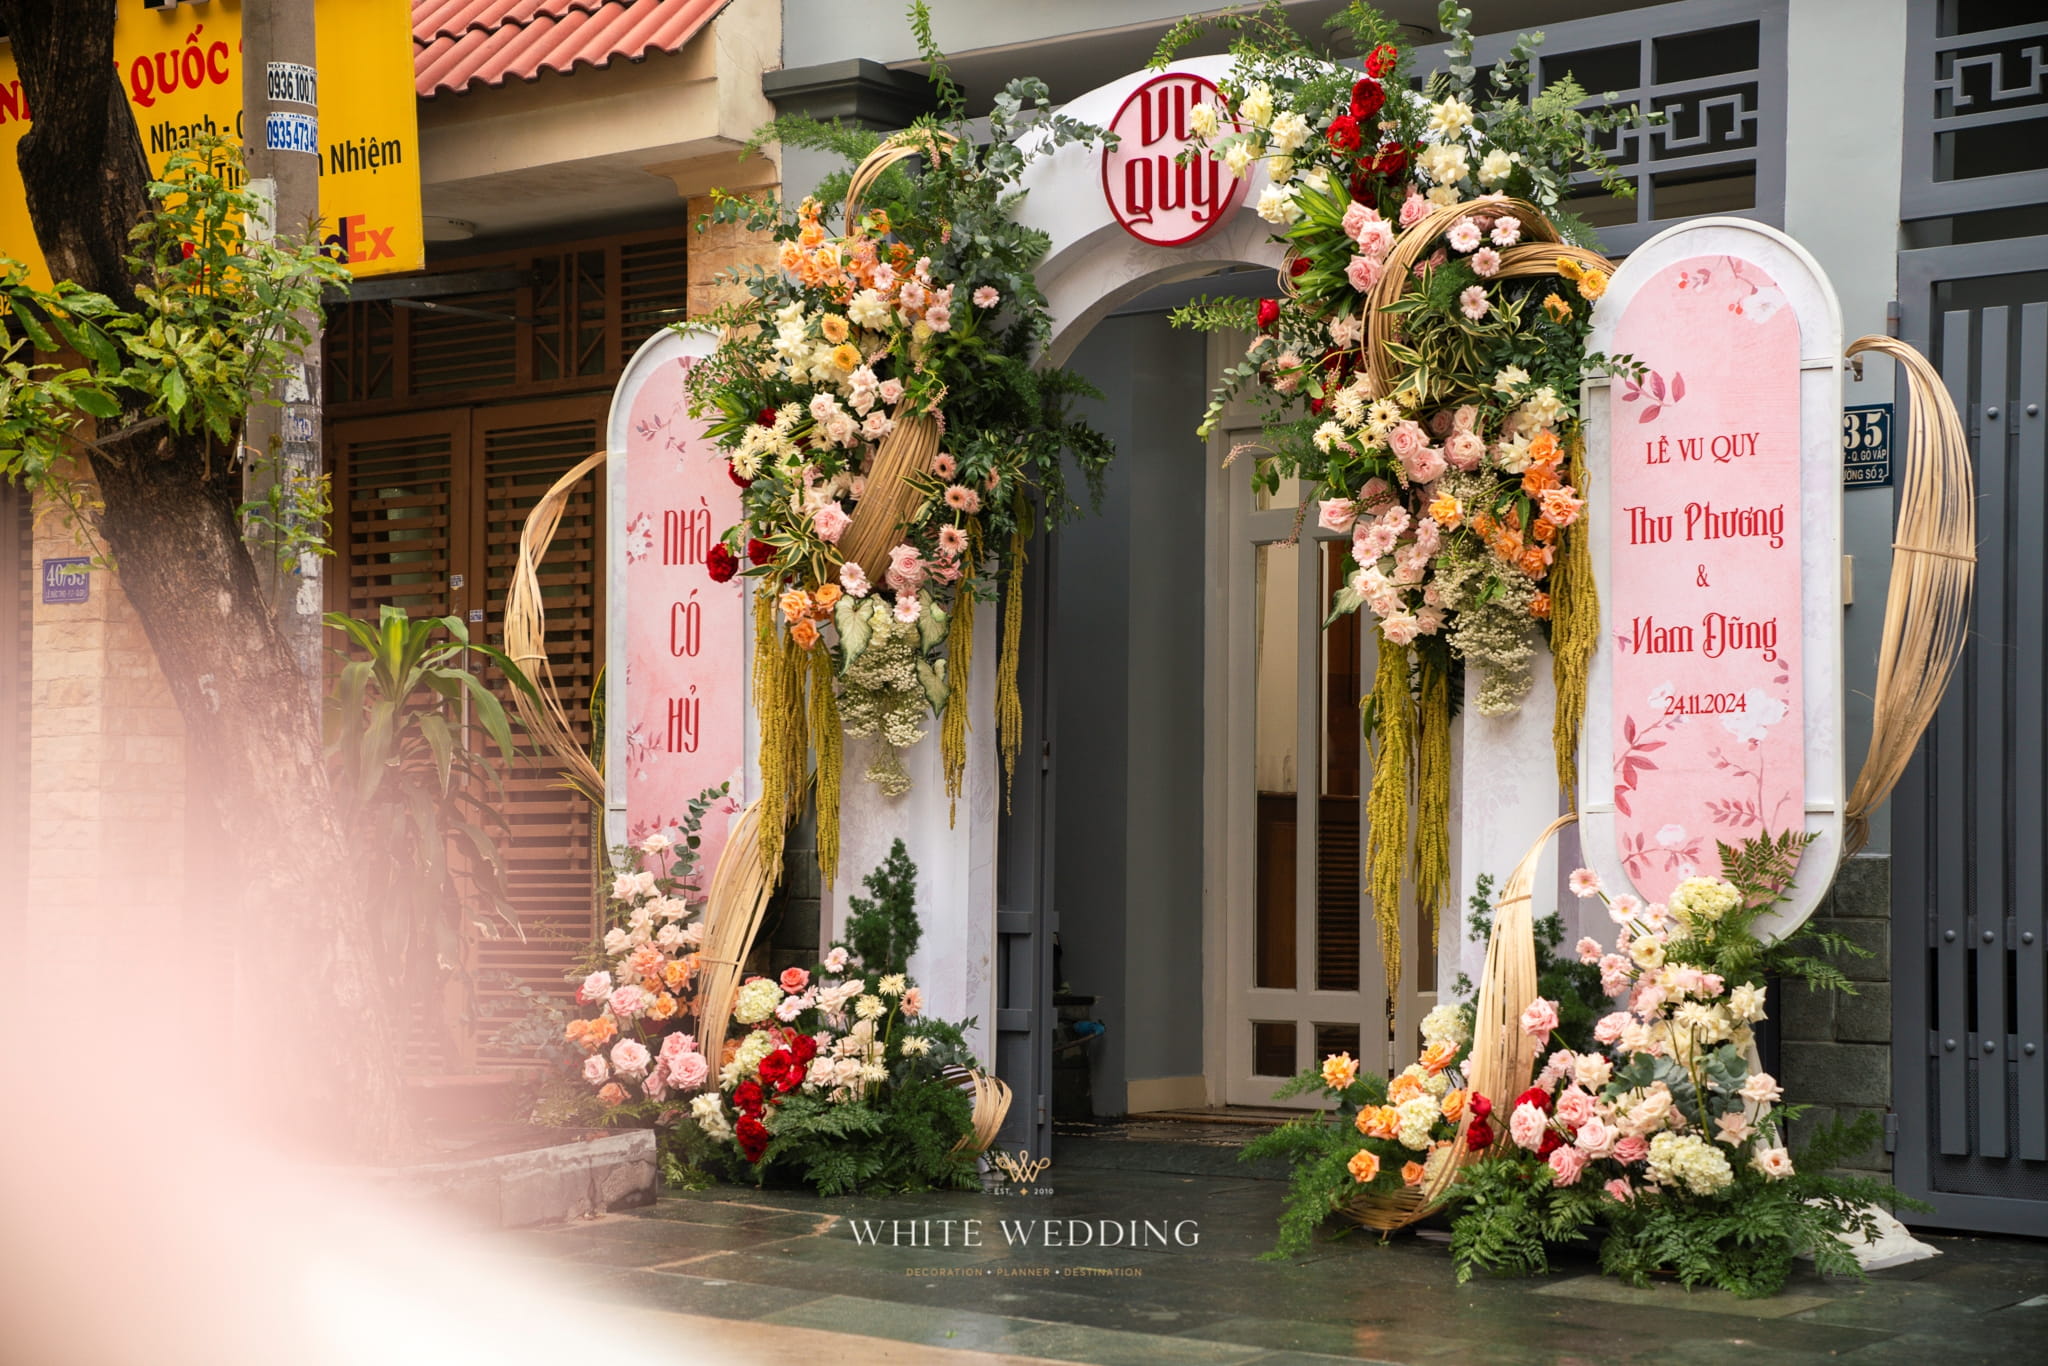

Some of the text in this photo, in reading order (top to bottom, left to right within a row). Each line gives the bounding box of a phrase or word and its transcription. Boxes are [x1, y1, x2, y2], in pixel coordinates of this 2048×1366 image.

[131, 24, 229, 108] QUỐC
[150, 113, 216, 154] Nhanh
[330, 137, 402, 175] Nhiệm
[319, 213, 396, 264] dEx
[1646, 432, 1760, 465] LỄ VU QUY
[1623, 501, 1784, 549] Thu Phương
[1696, 564, 1711, 588] &
[670, 588, 701, 657] CÓ
[1632, 615, 1695, 655] Nam
[1664, 693, 1747, 715] 24.11.2024
